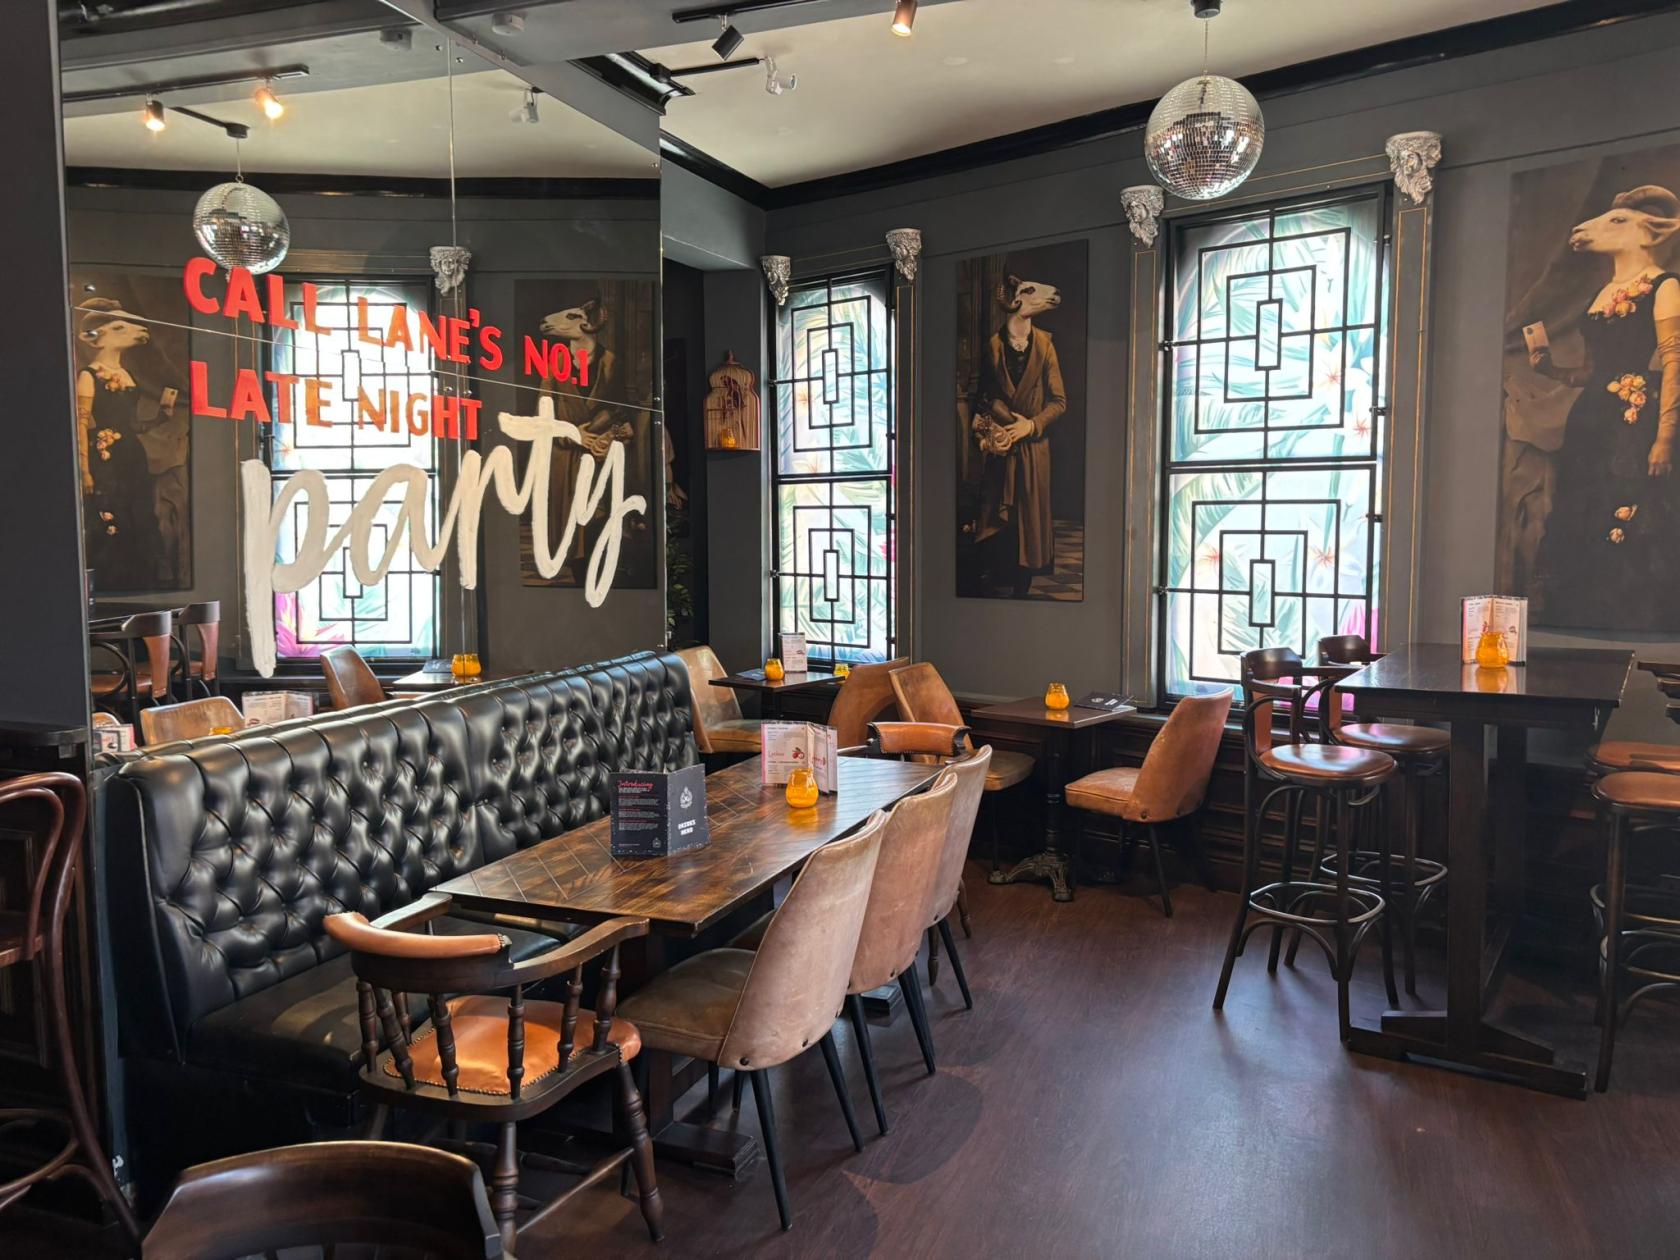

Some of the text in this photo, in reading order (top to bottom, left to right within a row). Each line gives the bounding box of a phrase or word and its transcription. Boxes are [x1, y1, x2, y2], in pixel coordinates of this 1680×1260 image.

[183, 257, 589, 387] CALL LANE'S NO.1
[190, 360, 483, 441] LATE NIGHT
[241, 395, 647, 679] party
